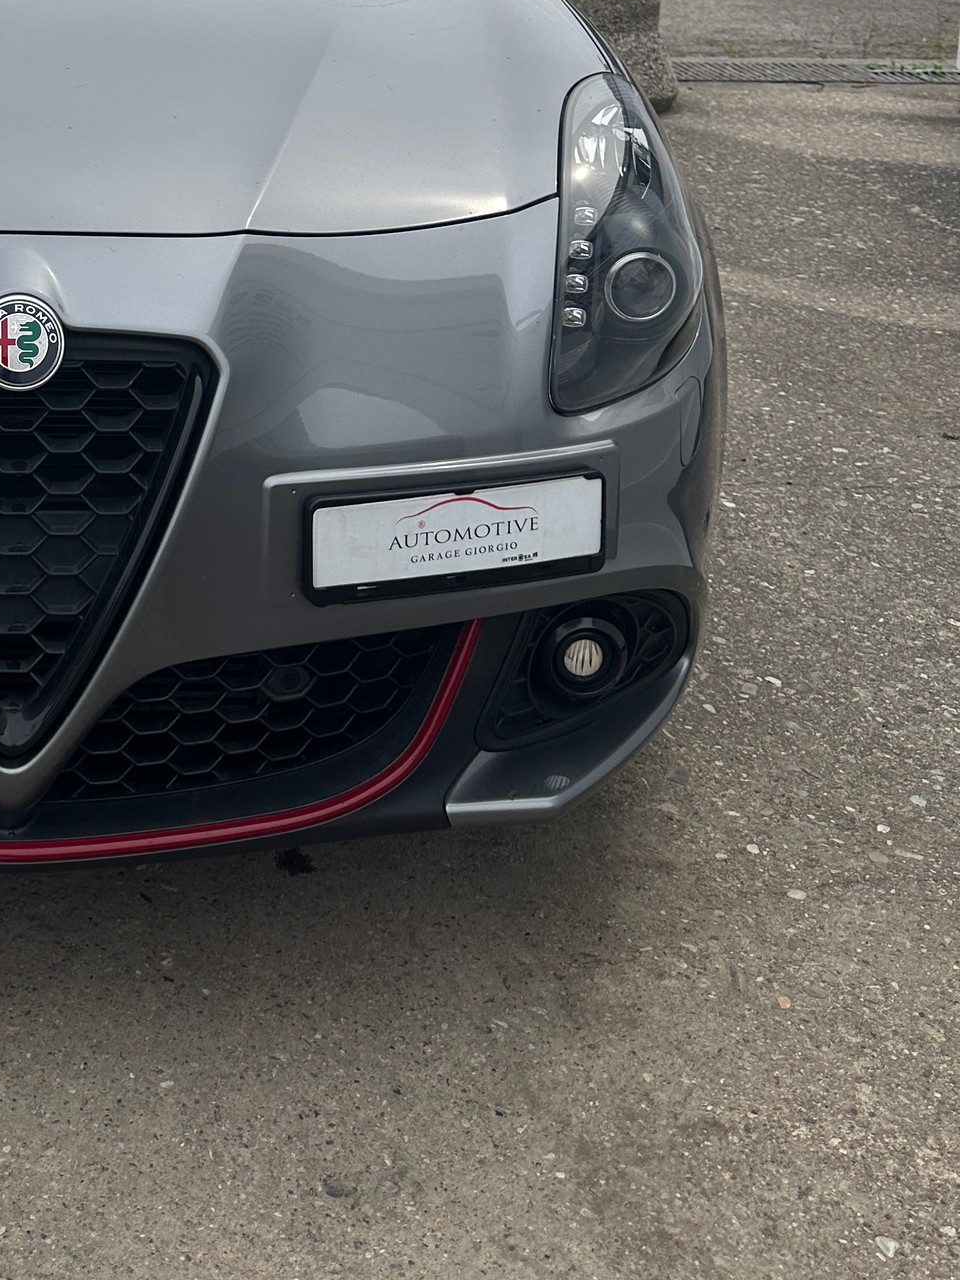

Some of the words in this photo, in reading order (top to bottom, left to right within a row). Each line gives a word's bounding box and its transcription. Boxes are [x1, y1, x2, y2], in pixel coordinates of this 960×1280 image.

[14, 304, 57, 343] ROMEO
[388, 516, 540, 551] AUTOMOTIVE
[410, 549, 461, 564] GARAGE
[465, 541, 518, 556] GIORGIO
